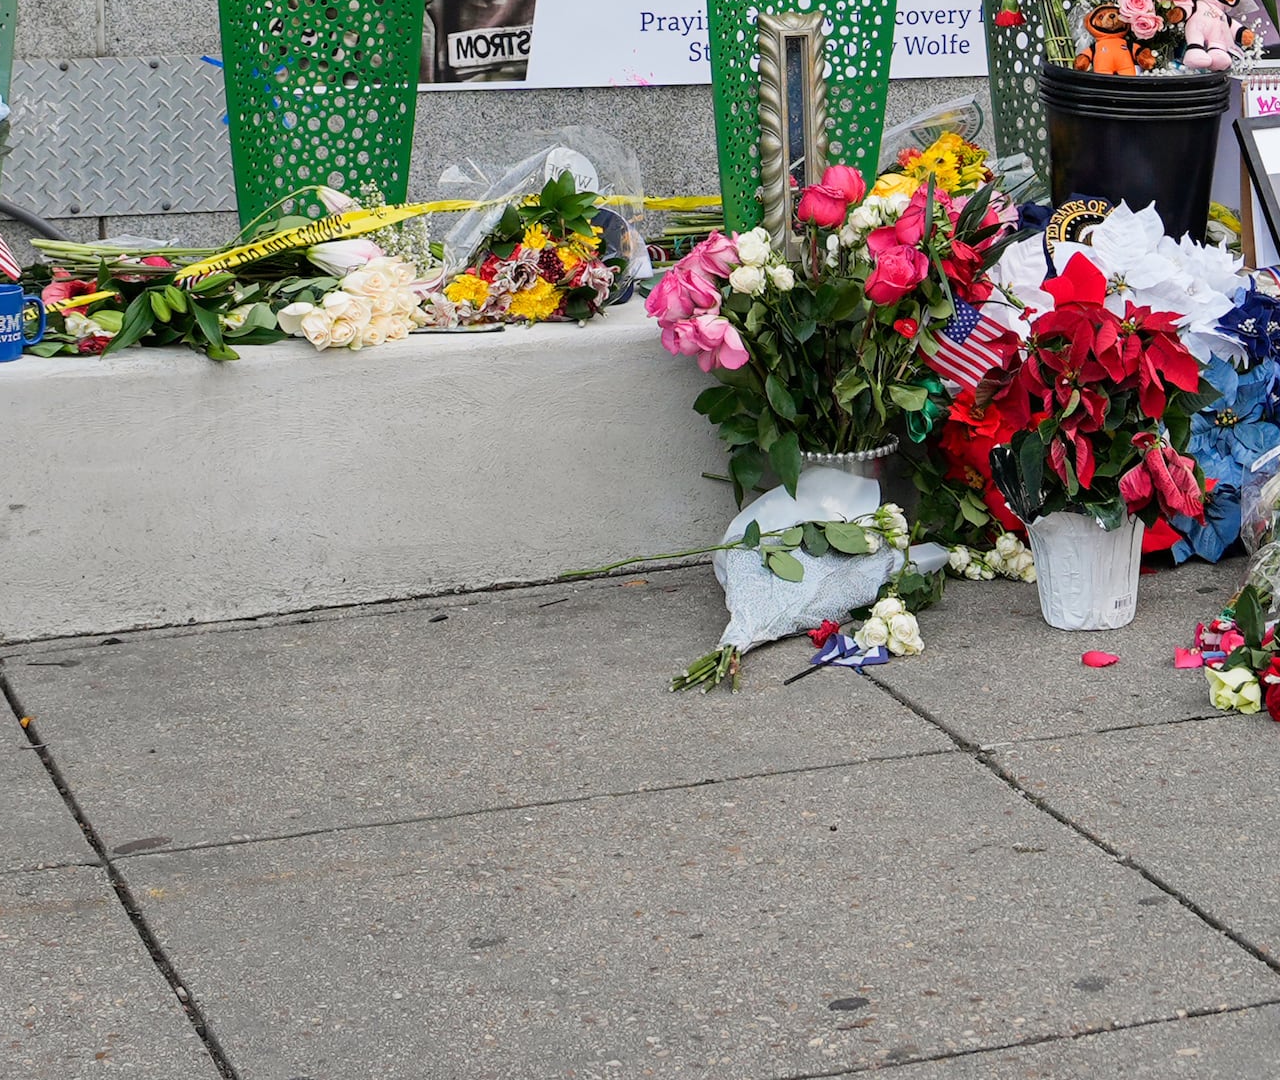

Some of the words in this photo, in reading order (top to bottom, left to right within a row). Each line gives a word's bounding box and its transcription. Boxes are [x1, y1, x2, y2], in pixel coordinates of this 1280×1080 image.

[640, 10, 710, 33] Prayi
[895, 7, 972, 29] covery
[905, 35, 970, 56] Wolfe
[1088, 200, 1108, 214] OF
